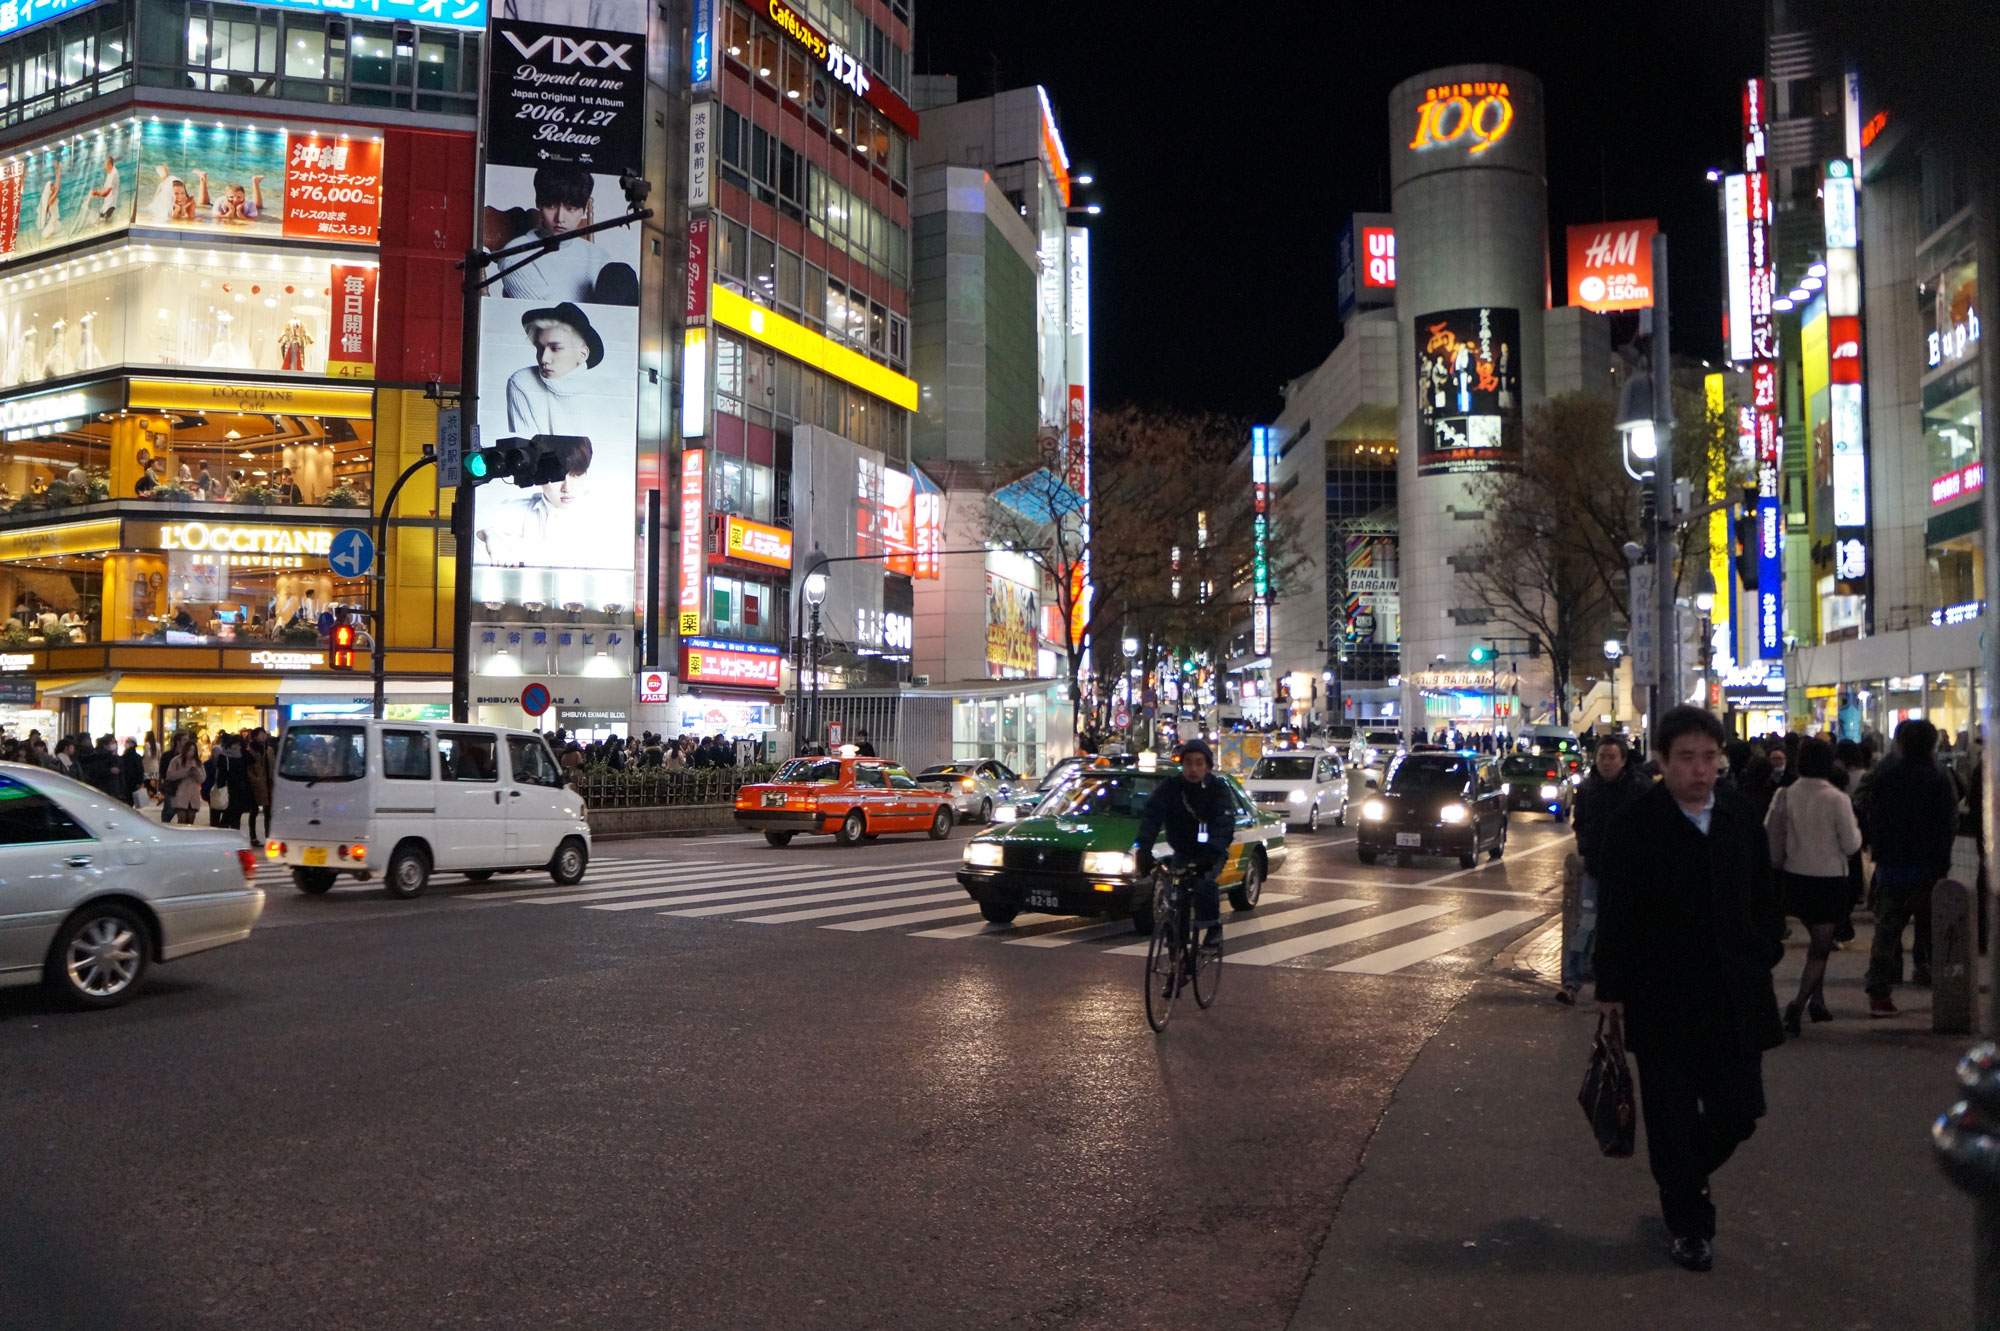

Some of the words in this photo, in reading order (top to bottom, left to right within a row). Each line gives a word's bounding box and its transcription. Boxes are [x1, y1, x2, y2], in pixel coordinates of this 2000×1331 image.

[501, 30, 633, 71] VIXX
[513, 64, 581, 87] Depend
[578, 78, 597, 87] on
[598, 79, 624, 90] me
[826, 42, 871, 97] ガスト
[511, 89, 539, 99] Japan
[540, 92, 576, 103] Original
[579, 96, 594, 105] 1st
[595, 97, 624, 107] Album
[1426, 83, 1509, 101] SHIBUYA
[515, 103, 617, 127] 2016.1.27
[1408, 94, 1514, 153] 109
[532, 123, 601, 145] Release
[290, 142, 349, 171] 沖縄
[693, 111, 706, 199] 渋谷駅前ビル
[3, 161, 24, 178] SALE
[289, 170, 378, 187] フォトウェディング
[290, 208, 348, 221] ドレスのまま
[689, 221, 708, 234] 5F
[1585, 230, 1639, 268] H&M
[1607, 285, 1649, 300] 150m
[342, 274, 365, 353] 毎日開催
[212, 386, 293, 401] L'OCCITANE
[239, 400, 265, 411] Café
[447, 415, 458, 481] 渋谷駅前
[160, 522, 333, 555] L'OCCITANE
[731, 527, 742, 548] 薬
[192, 555, 212, 565] EN
[220, 556, 304, 567] PROVENCE
[1350, 569, 1380, 580] FINAL
[1350, 580, 1397, 591] BARGAIN
[682, 613, 698, 632] 薬
[482, 631, 622, 646] 渋谷駅前ビル
[250, 651, 325, 665] L'OCCITANE
[691, 655, 700, 673] 薬
[1443, 675, 1494, 685] BARGAIN
[476, 696, 520, 704] SHIBUYA
[587, 711, 609, 719] EKIMAE
